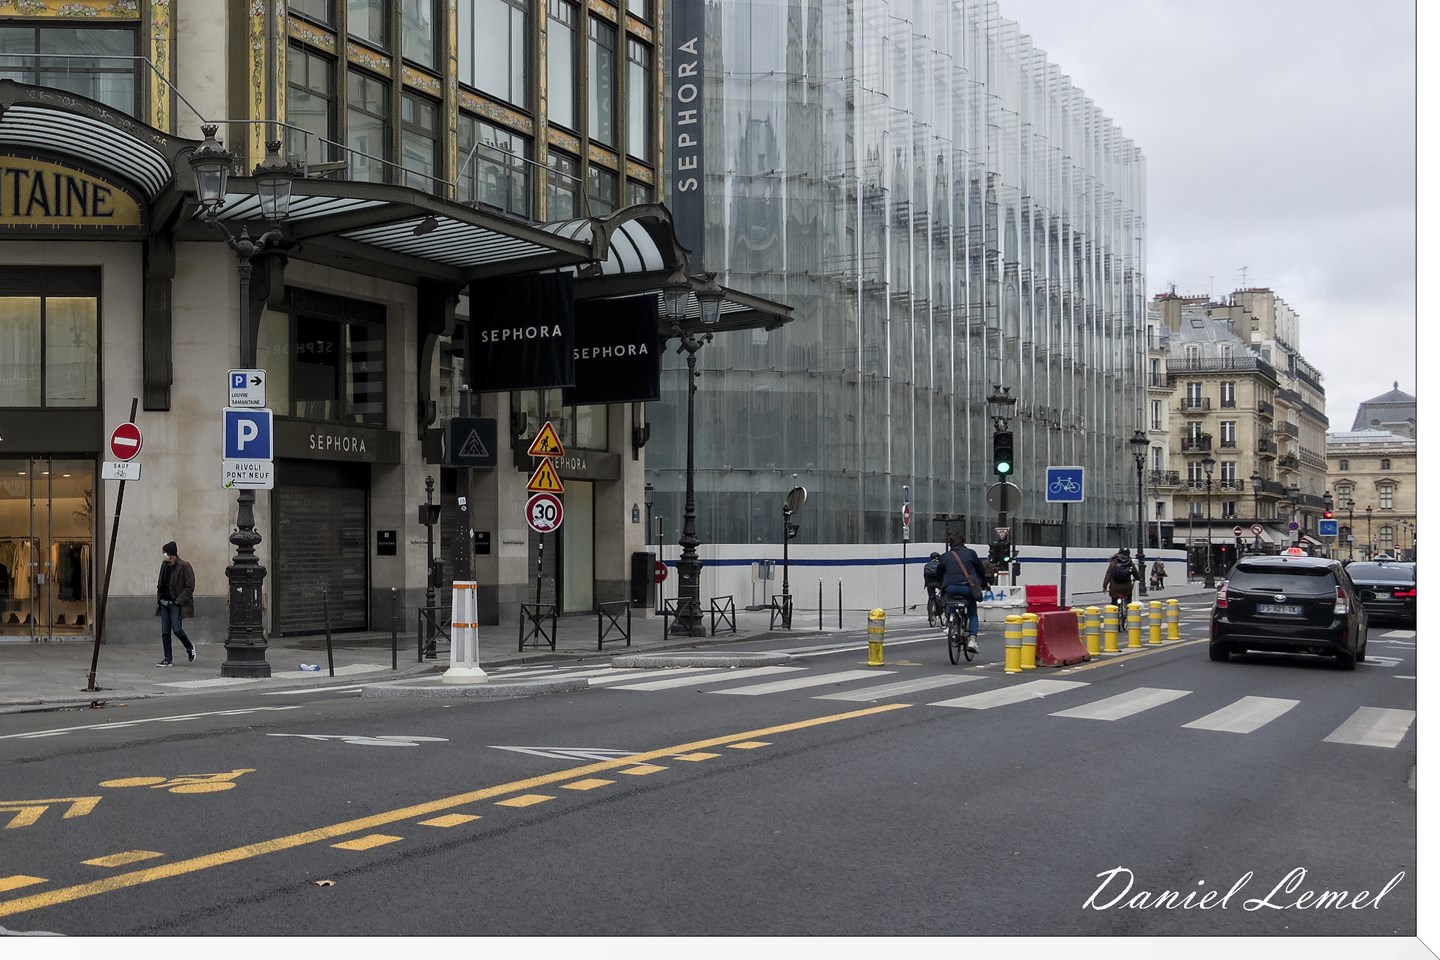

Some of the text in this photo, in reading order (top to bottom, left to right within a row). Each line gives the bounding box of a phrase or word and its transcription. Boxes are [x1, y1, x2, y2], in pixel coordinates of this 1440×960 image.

[677, 36, 699, 192] SEPHORA
[481, 324, 562, 343] SEPHORA
[573, 343, 648, 360] SEPHORA
[235, 375, 243, 387] P
[237, 419, 258, 451] P
[309, 434, 367, 453] SEPHORA
[552, 457, 587, 470] EPHORA
[226, 471, 246, 479] PONT
[534, 504, 556, 521] 30
